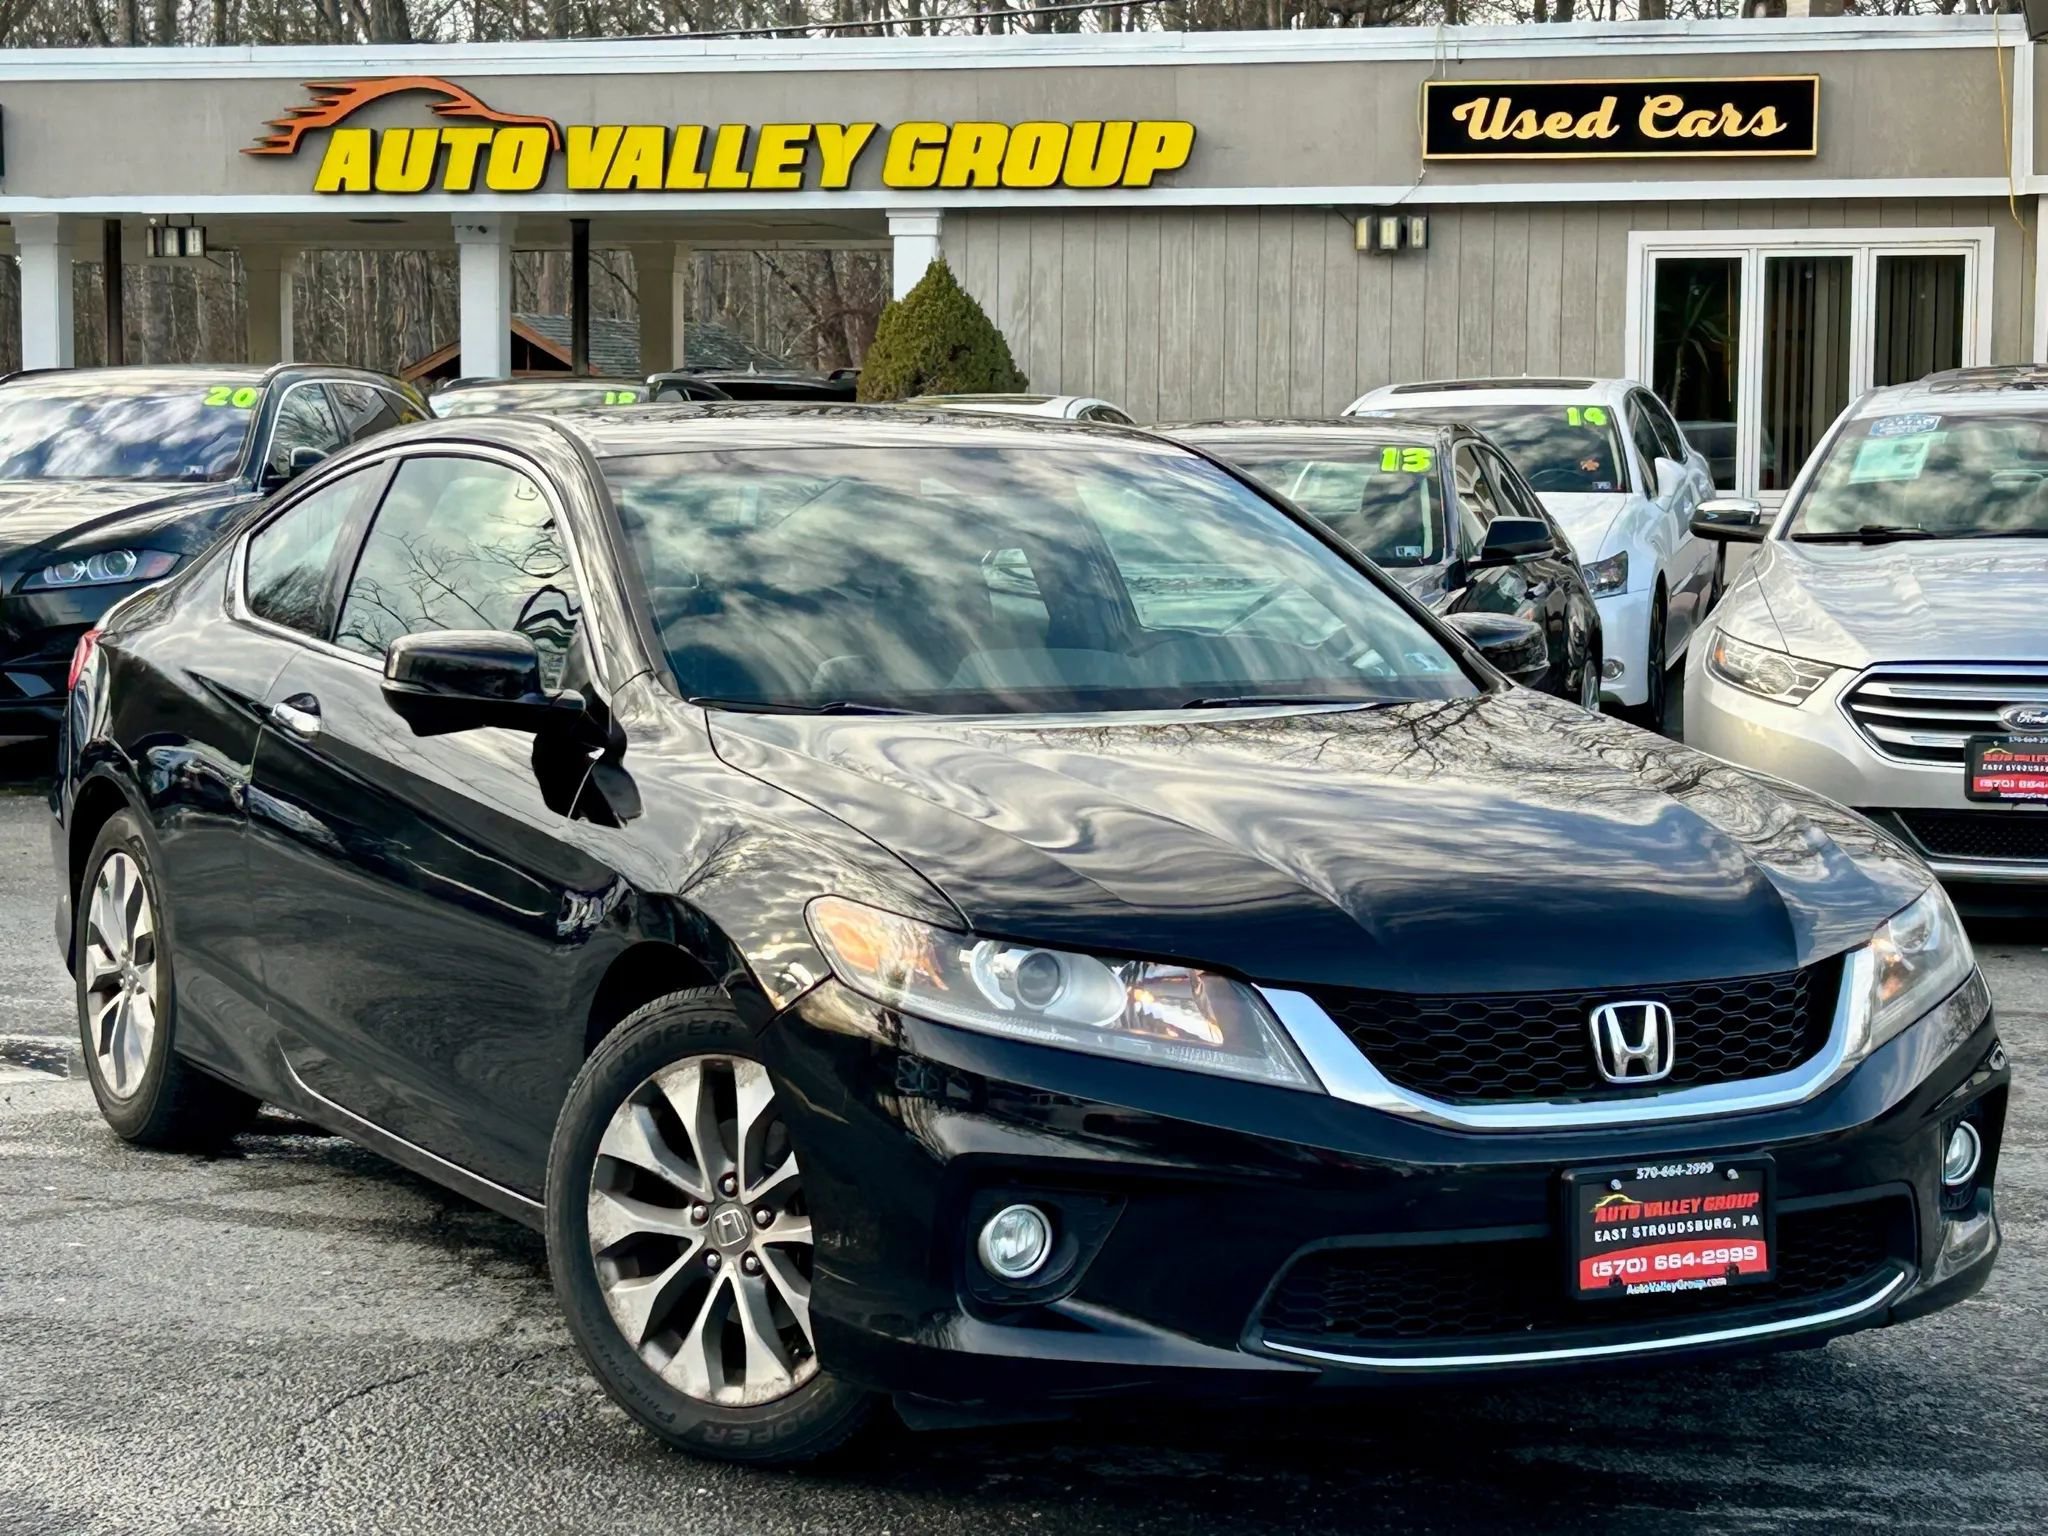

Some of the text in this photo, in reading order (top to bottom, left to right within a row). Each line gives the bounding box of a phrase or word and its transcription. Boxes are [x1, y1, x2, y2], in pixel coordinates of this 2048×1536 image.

[1451, 94, 1788, 140] Used Cars
[314, 120, 1195, 191] AUTO VALLEY GROUP
[203, 386, 258, 408] 20
[1380, 446, 1432, 472] 13
[1635, 1161, 1715, 1180] 570-664-2999
[1595, 1192, 1760, 1223] AUTO VALLEY GROUP
[1594, 1214, 1759, 1243] EAST STROUDSBURG, PA
[1591, 1246, 1758, 1278] (570) 664-2999
[1626, 1278, 1728, 1295] AutoValleyGroup.com
[703, 1387, 835, 1446] OOPER
